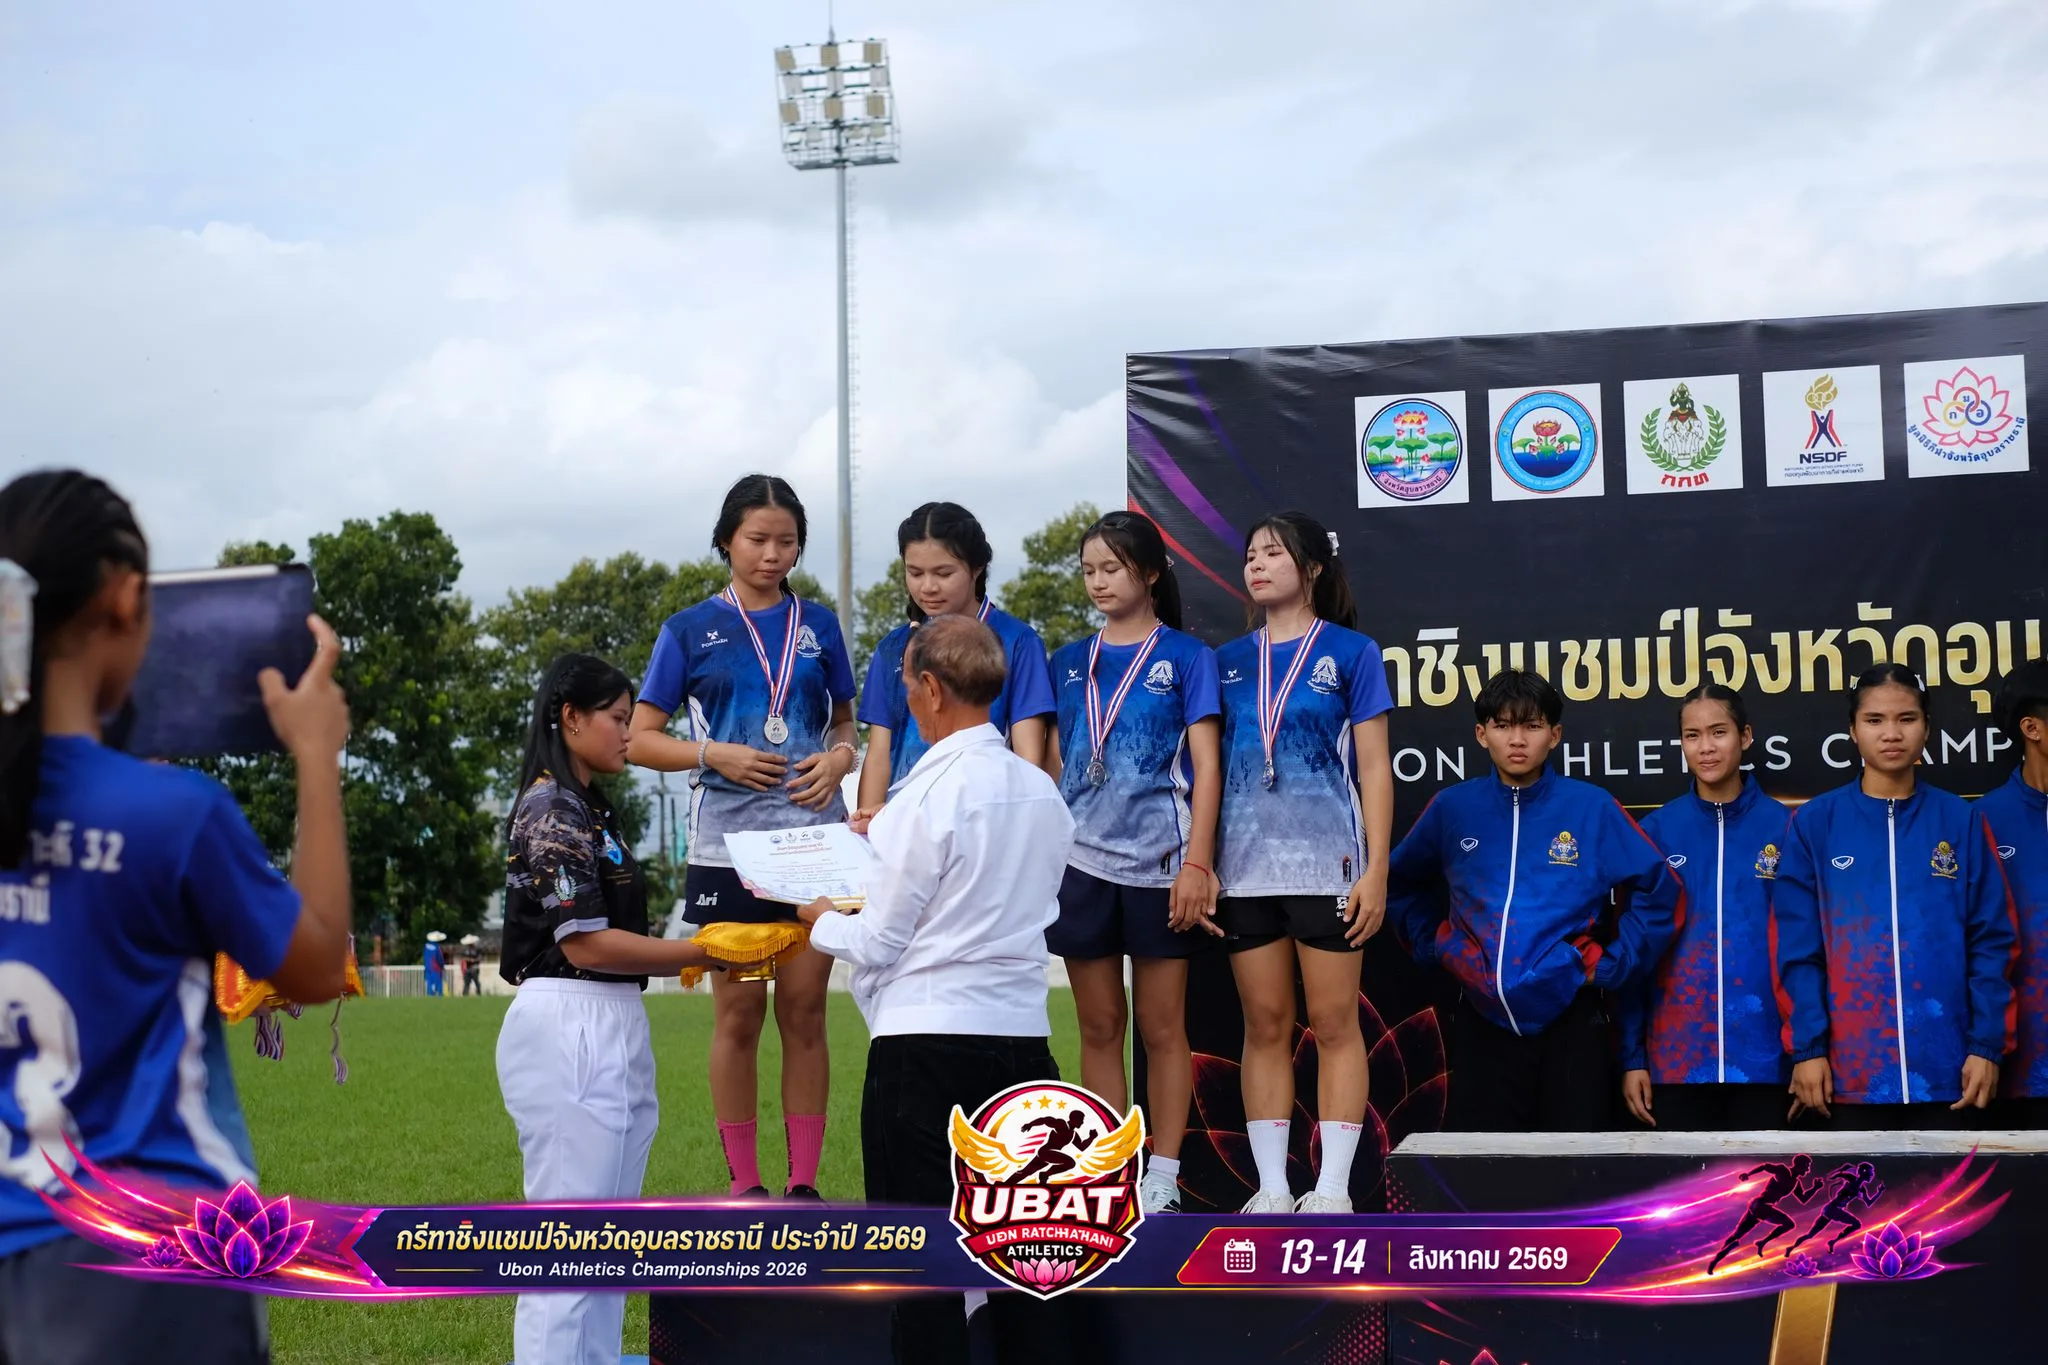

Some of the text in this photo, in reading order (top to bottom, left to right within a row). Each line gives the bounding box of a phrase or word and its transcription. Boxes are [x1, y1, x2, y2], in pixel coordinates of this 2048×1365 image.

[1799, 451, 1847, 464] NSDF
[80, 828, 125, 873] 32
[695, 892, 718, 906] Ari
